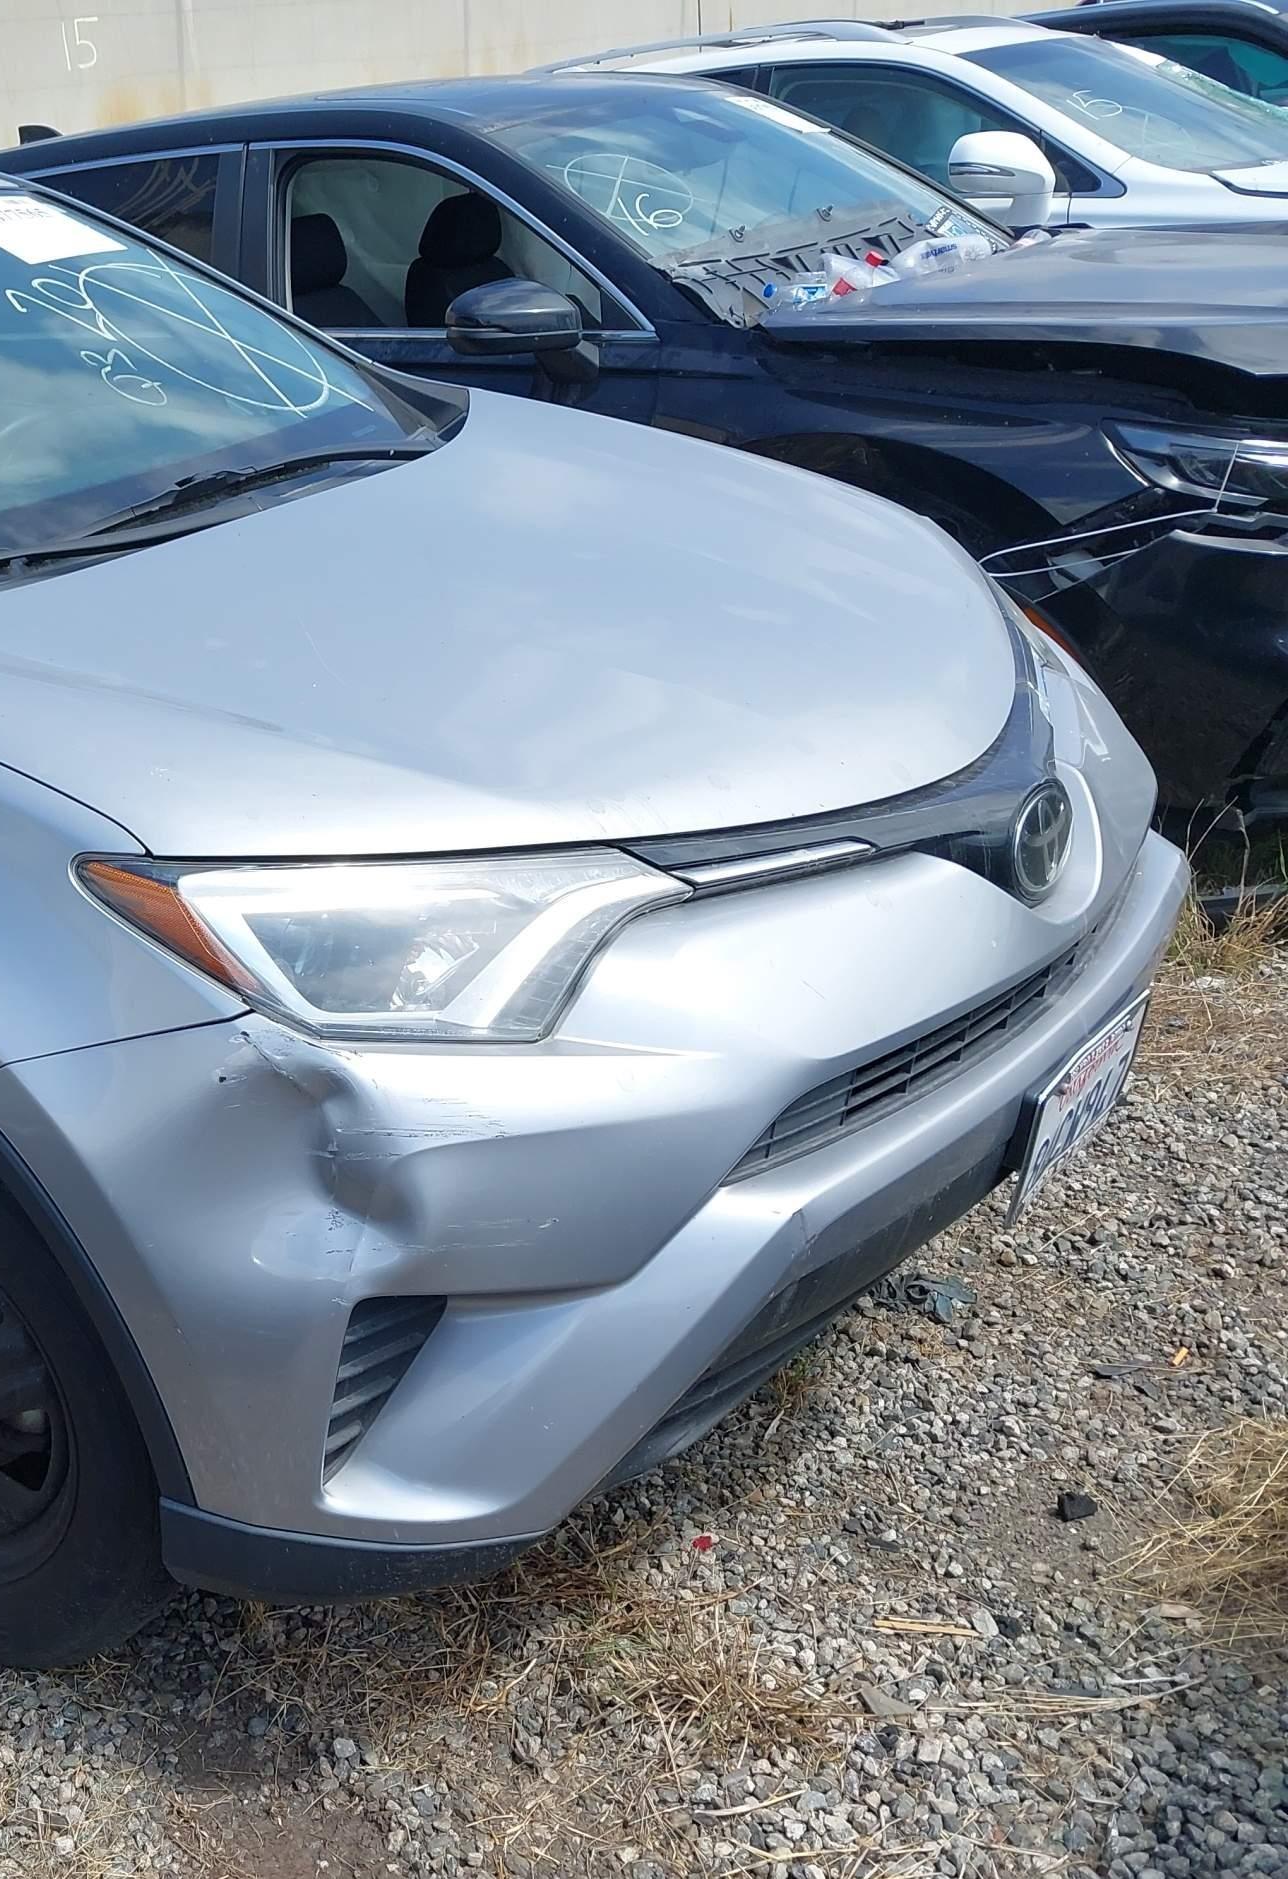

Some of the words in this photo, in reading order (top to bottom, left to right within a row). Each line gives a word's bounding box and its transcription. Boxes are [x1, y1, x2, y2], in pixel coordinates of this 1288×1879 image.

[62, 17, 98, 70] 15
[1066, 90, 1122, 120] 15
[617, 193, 683, 236] 16
